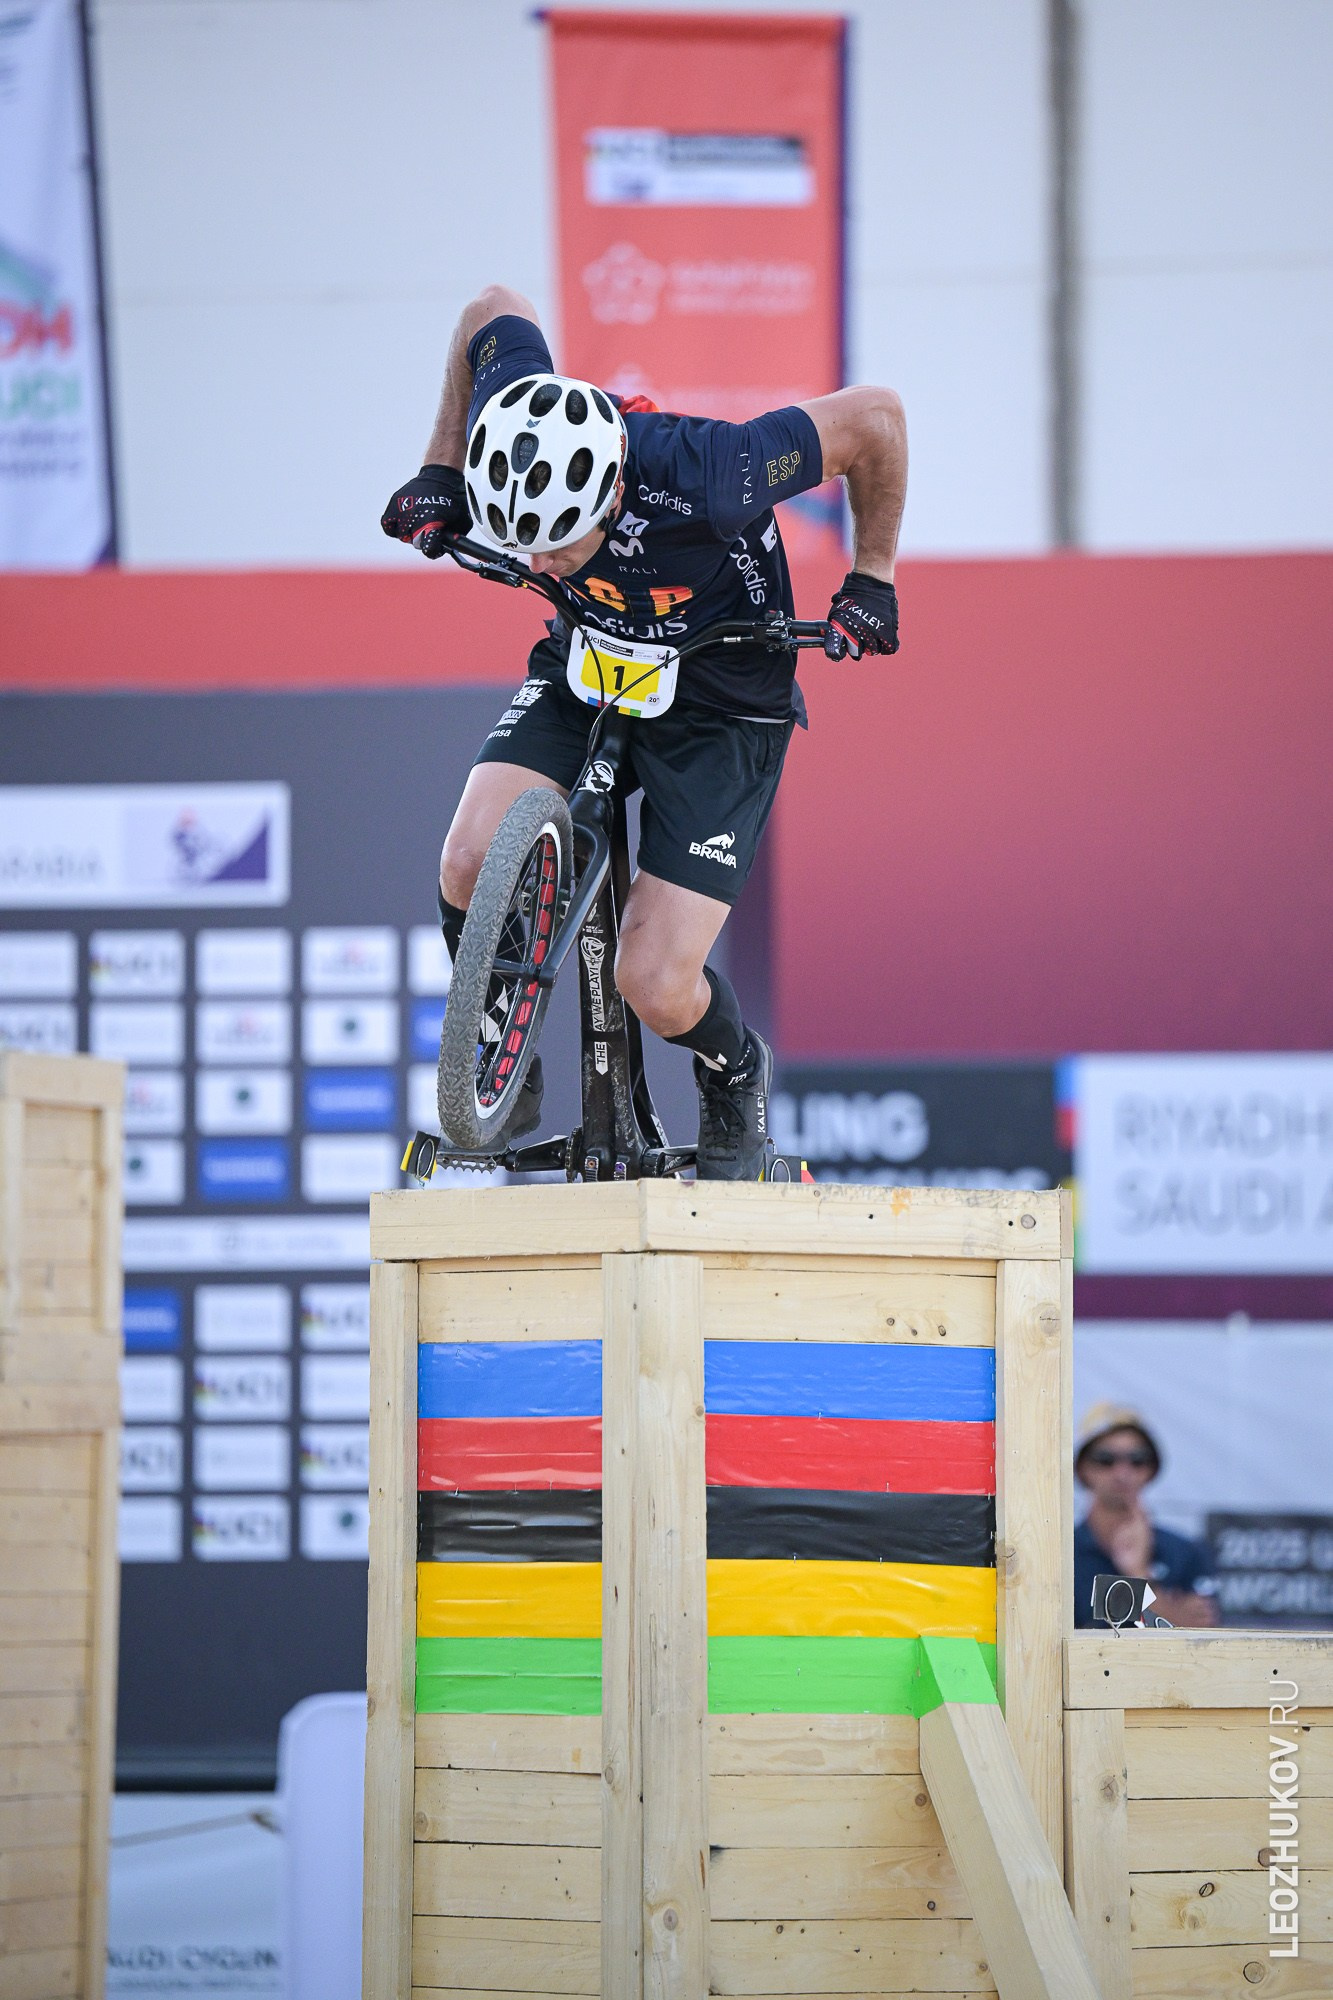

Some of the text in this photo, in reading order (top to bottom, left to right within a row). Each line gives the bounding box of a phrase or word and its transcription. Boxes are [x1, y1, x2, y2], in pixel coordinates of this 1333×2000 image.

[739, 452, 753, 505] RALI
[766, 450, 801, 487] ESP
[415, 495, 452, 507] KALEY
[637, 484, 693, 516] Cofidis
[618, 565, 658, 574] RALI
[728, 536, 766, 606] Cofidis
[848, 605, 885, 630] KALEY
[613, 665, 626, 692] 1
[592, 998, 602, 1016] WE
[596, 1043, 606, 1065] THE
